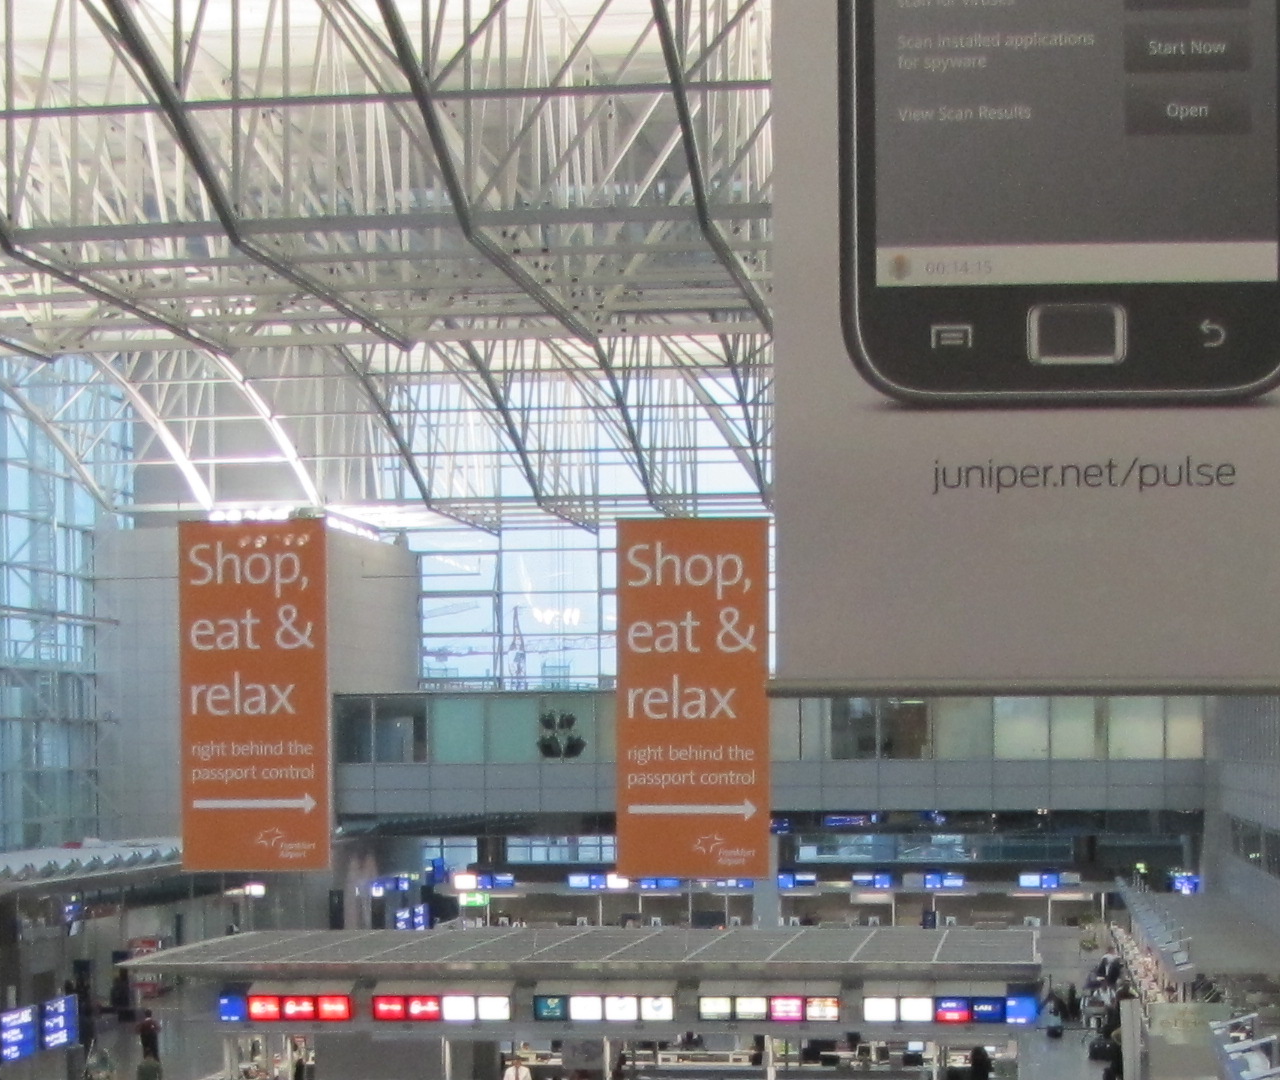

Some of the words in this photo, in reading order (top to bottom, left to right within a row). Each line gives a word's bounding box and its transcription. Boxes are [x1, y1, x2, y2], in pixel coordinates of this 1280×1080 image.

[897, 34, 933, 50] Scan
[938, 32, 1001, 49] installed
[1005, 32, 1096, 51] applications
[1147, 40, 1186, 56] Start
[1190, 40, 1227, 55] Now
[897, 54, 919, 70] for
[922, 55, 988, 73] spyware
[898, 107, 934, 123] View
[937, 105, 975, 122] Scan
[978, 104, 1033, 121] Results
[1166, 102, 1209, 121] Open
[931, 456, 1238, 495] juniper.net/pulse
[188, 540, 310, 599] Shop,
[626, 541, 753, 600] Shop,
[189, 607, 262, 651] eat
[274, 603, 316, 651] &
[626, 610, 702, 653] eat
[715, 606, 758, 653] &
[189, 670, 297, 716] relax
[626, 673, 738, 720] relax
[191, 740, 228, 762] right
[231, 740, 284, 757] behind
[288, 740, 314, 757] the
[626, 745, 664, 767] right
[668, 744, 724, 762] behind
[728, 744, 756, 762] the
[191, 765, 258, 784] passport
[261, 762, 316, 780] control
[626, 769, 696, 789] passport
[699, 768, 756, 786] control
